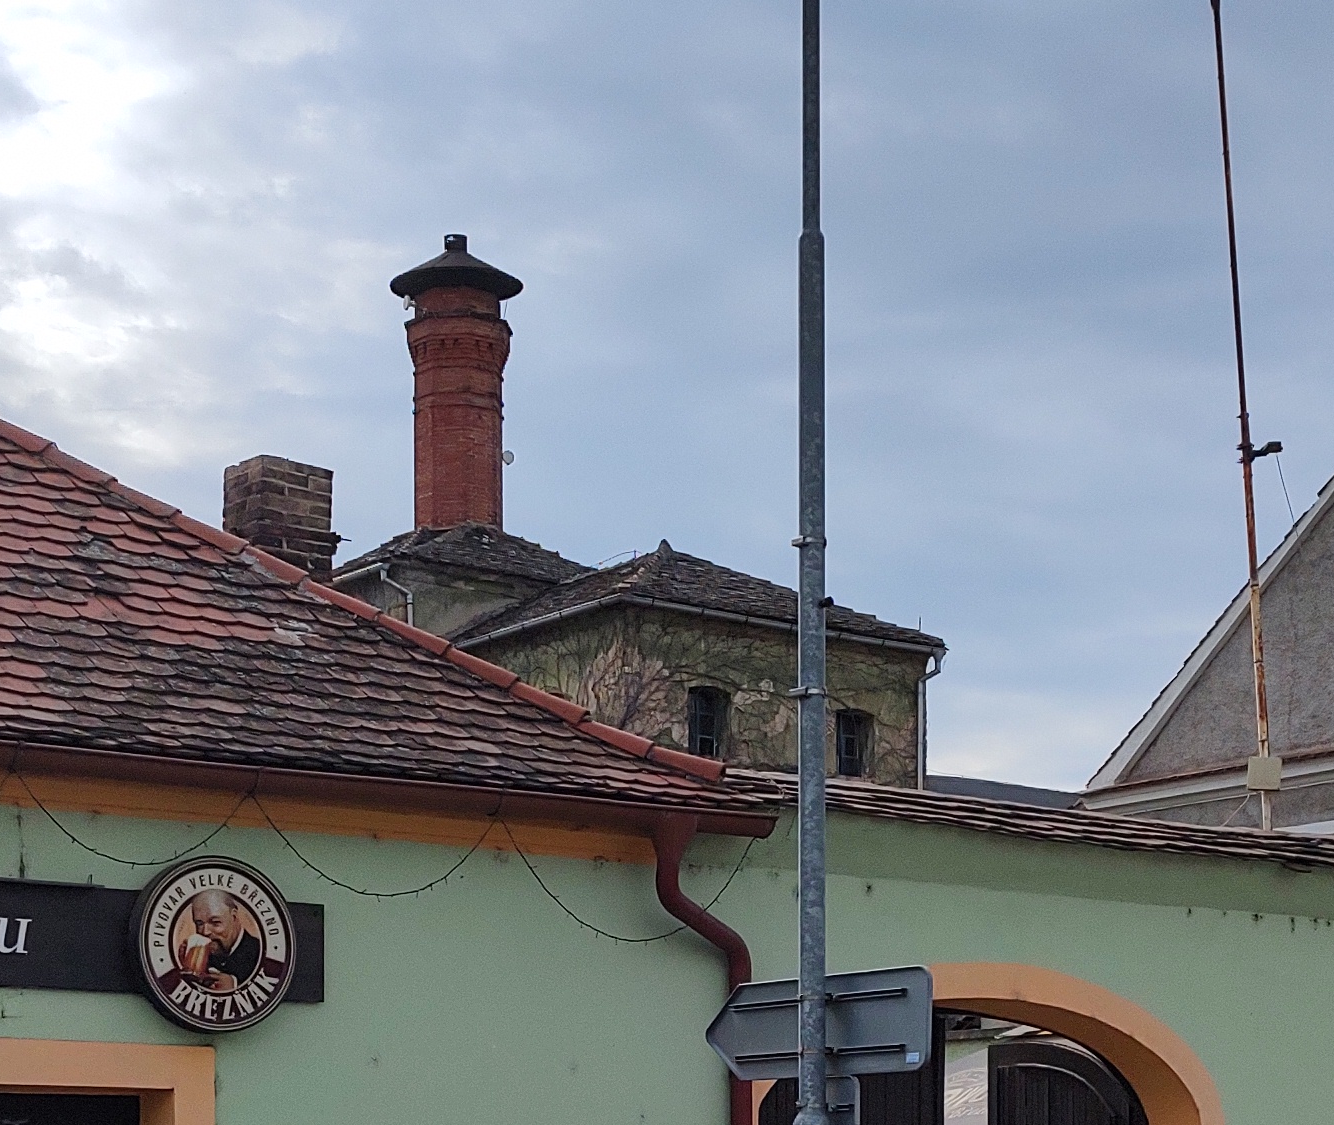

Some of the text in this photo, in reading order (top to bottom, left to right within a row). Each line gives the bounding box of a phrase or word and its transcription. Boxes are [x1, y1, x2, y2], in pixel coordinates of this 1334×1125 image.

[154, 874, 280, 948] PIVOVAR VELKÉ BŘEZNO
[169, 967, 280, 1021] BŘEZŇÁK
